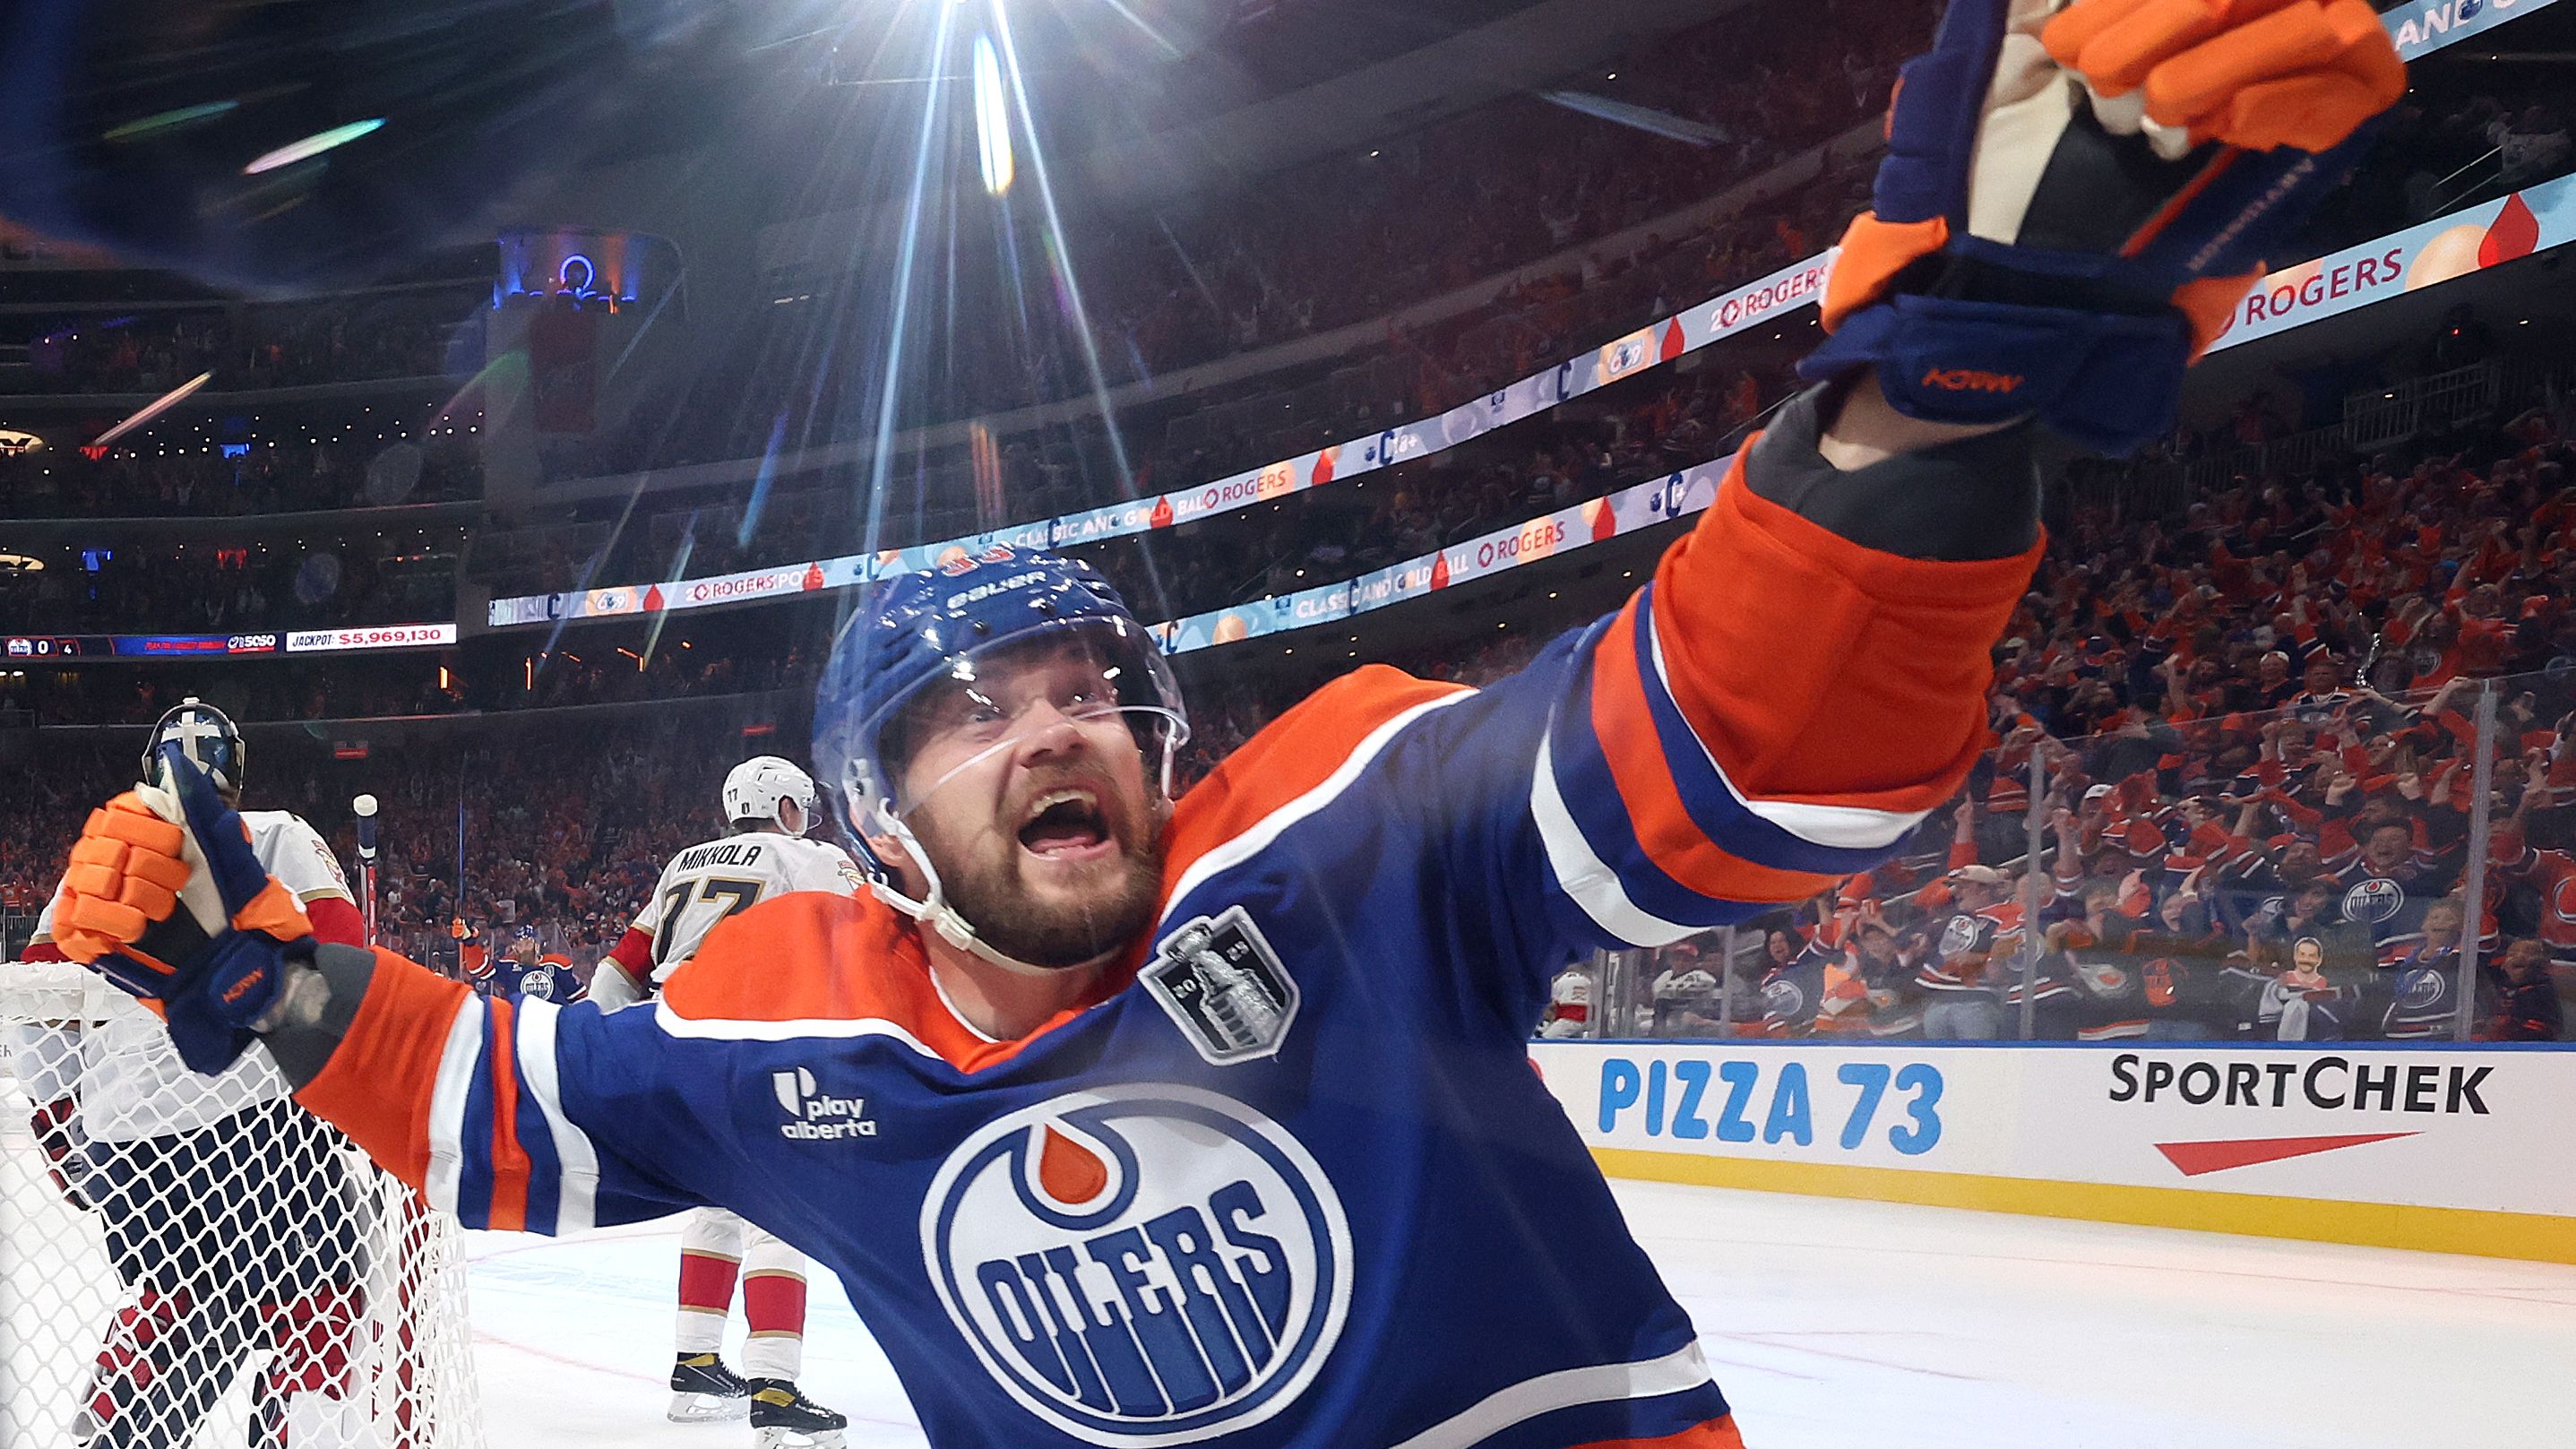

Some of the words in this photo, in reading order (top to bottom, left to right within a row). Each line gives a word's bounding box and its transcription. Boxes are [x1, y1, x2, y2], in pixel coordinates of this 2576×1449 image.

[2244, 248, 2402, 325] ROGERS
[1222, 470, 1287, 502] ROGERS
[1497, 522, 1565, 560] ROGERS
[712, 574, 774, 598] ROGERS
[38, 640, 48, 654] 0
[292, 633, 335, 648] JACKPOT:
[339, 629, 442, 645] $5,969,130
[677, 844, 762, 873] MIKKOLA
[650, 875, 766, 967] 77
[2108, 1054, 2495, 1115] SPORTCHEK
[806, 1095, 864, 1121] play
[1598, 1058, 1813, 1146] PIZZA
[1837, 1063, 1943, 1155] 73
[781, 1118, 877, 1139] alberta
[977, 1179, 1293, 1417] OILERS
